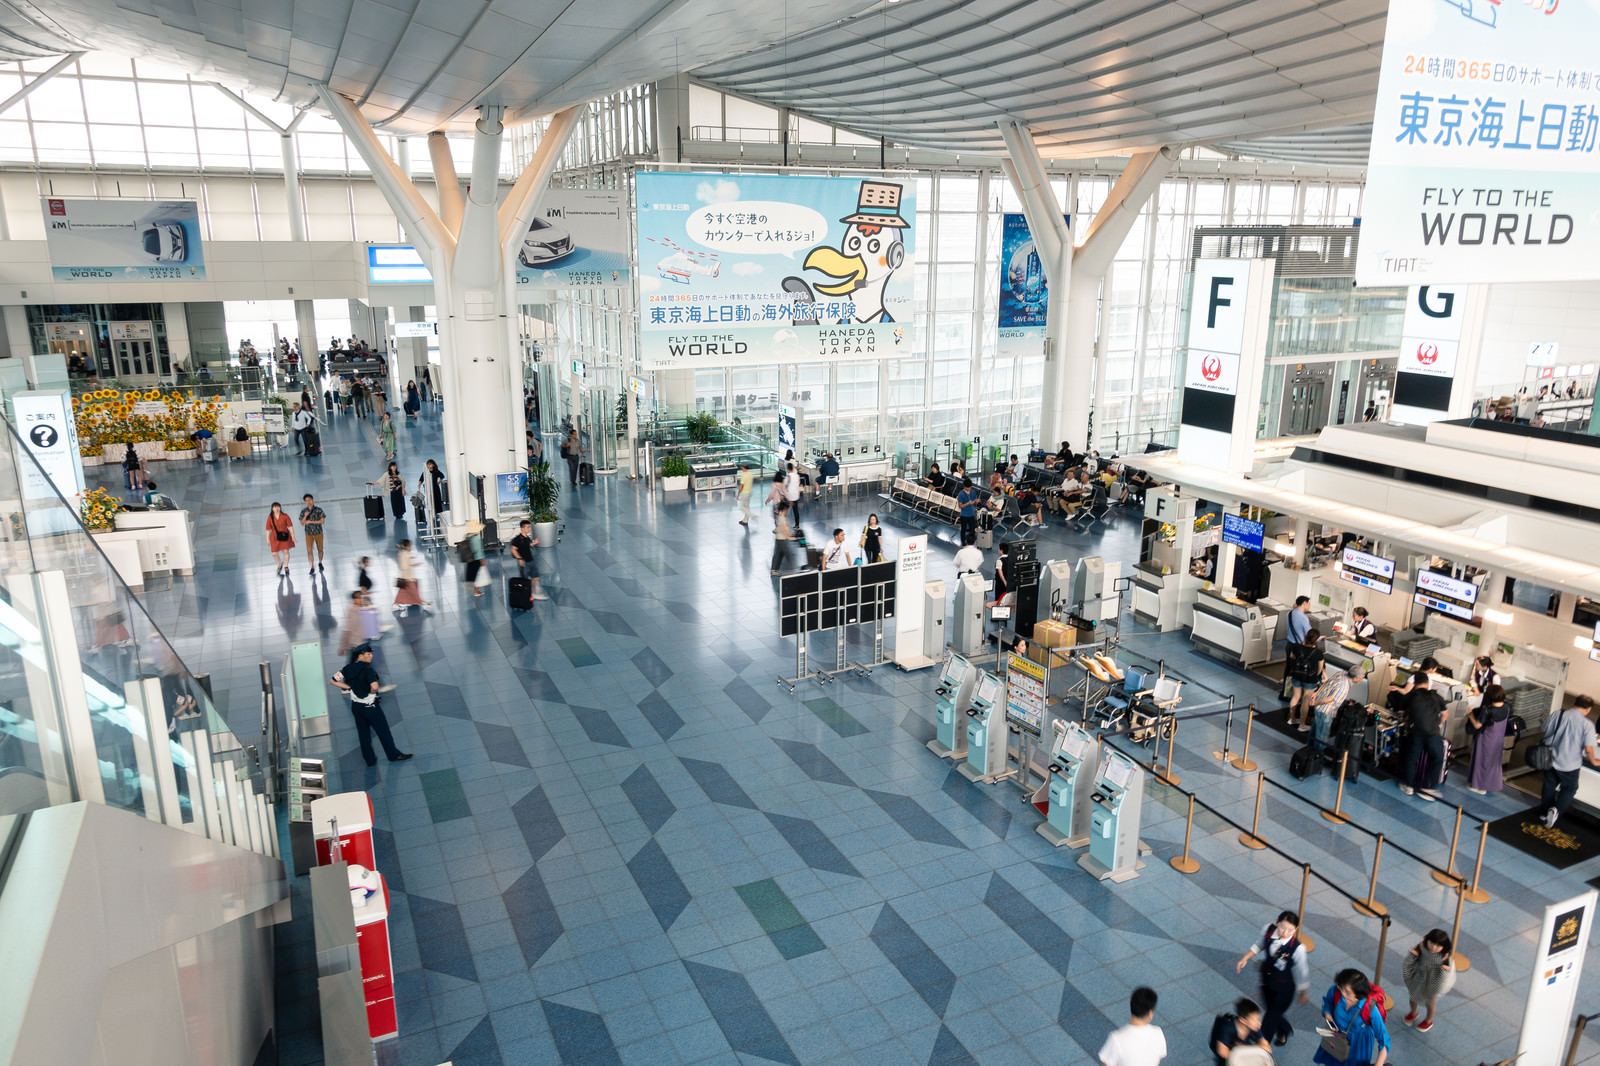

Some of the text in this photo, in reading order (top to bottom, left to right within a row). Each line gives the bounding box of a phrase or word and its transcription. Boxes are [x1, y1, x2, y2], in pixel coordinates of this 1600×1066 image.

[1396, 91, 1600, 152] 東京海上日動
[1423, 188, 1553, 207] FLY TO THE
[704, 212, 768, 226] 今すぐ空港の
[1421, 213, 1574, 246] WORLD
[1385, 258, 1418, 272] TIAT
[1207, 276, 1234, 328] F
[1418, 286, 1454, 318] G
[650, 302, 857, 324] 東京海上日動の海外旅行保険
[819, 328, 875, 337] HANEDA
[669, 342, 748, 356] WORLD
[819, 338, 875, 346] TOKYO
[820, 346, 875, 355] JAPAN
[26, 413, 56, 422] ご案内
[1156, 498, 1166, 516] F
